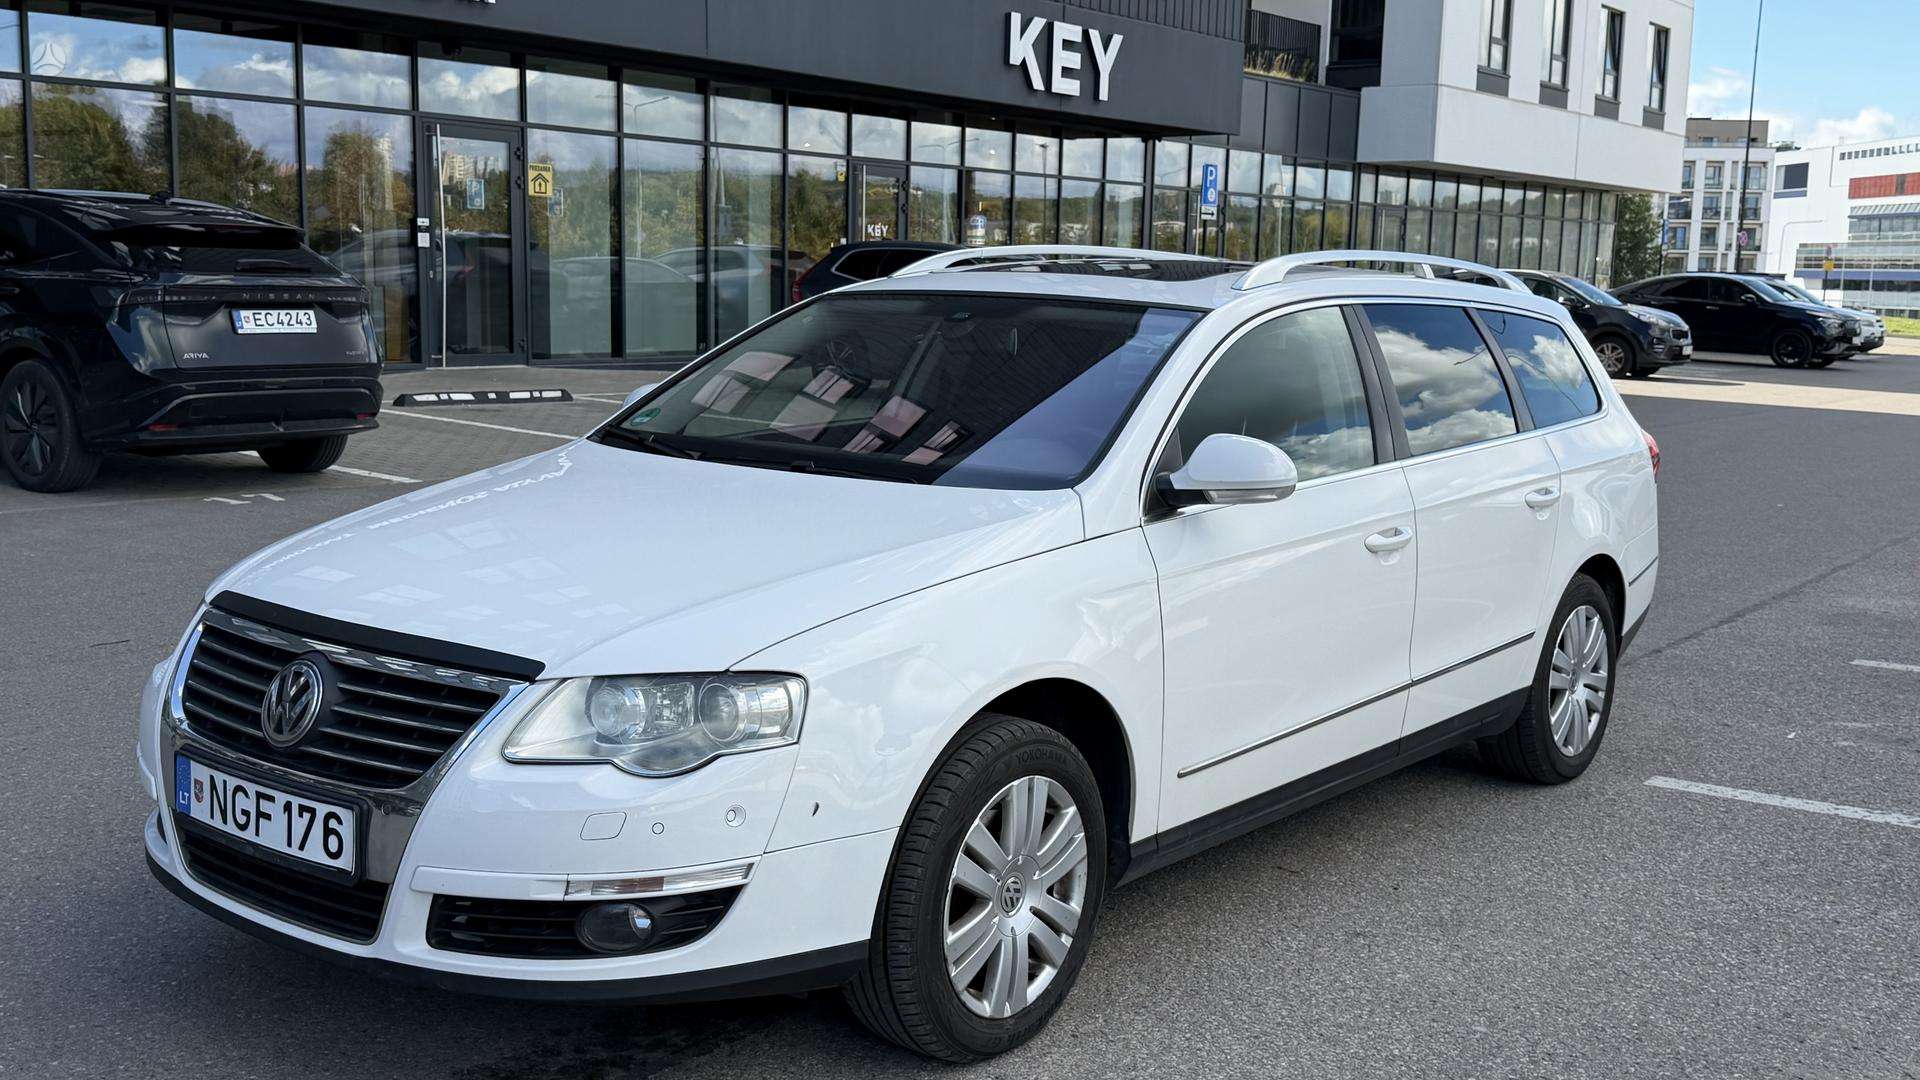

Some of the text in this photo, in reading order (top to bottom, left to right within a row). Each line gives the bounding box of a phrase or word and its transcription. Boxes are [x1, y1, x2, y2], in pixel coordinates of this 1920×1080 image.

[1006, 12, 1124, 101] KEY
[1207, 166, 1216, 188] P
[867, 224, 889, 237] KEY
[242, 292, 316, 300] NISSAN
[252, 312, 314, 327] EC4243
[183, 352, 209, 360] ARIYA
[180, 790, 189, 805] LT
